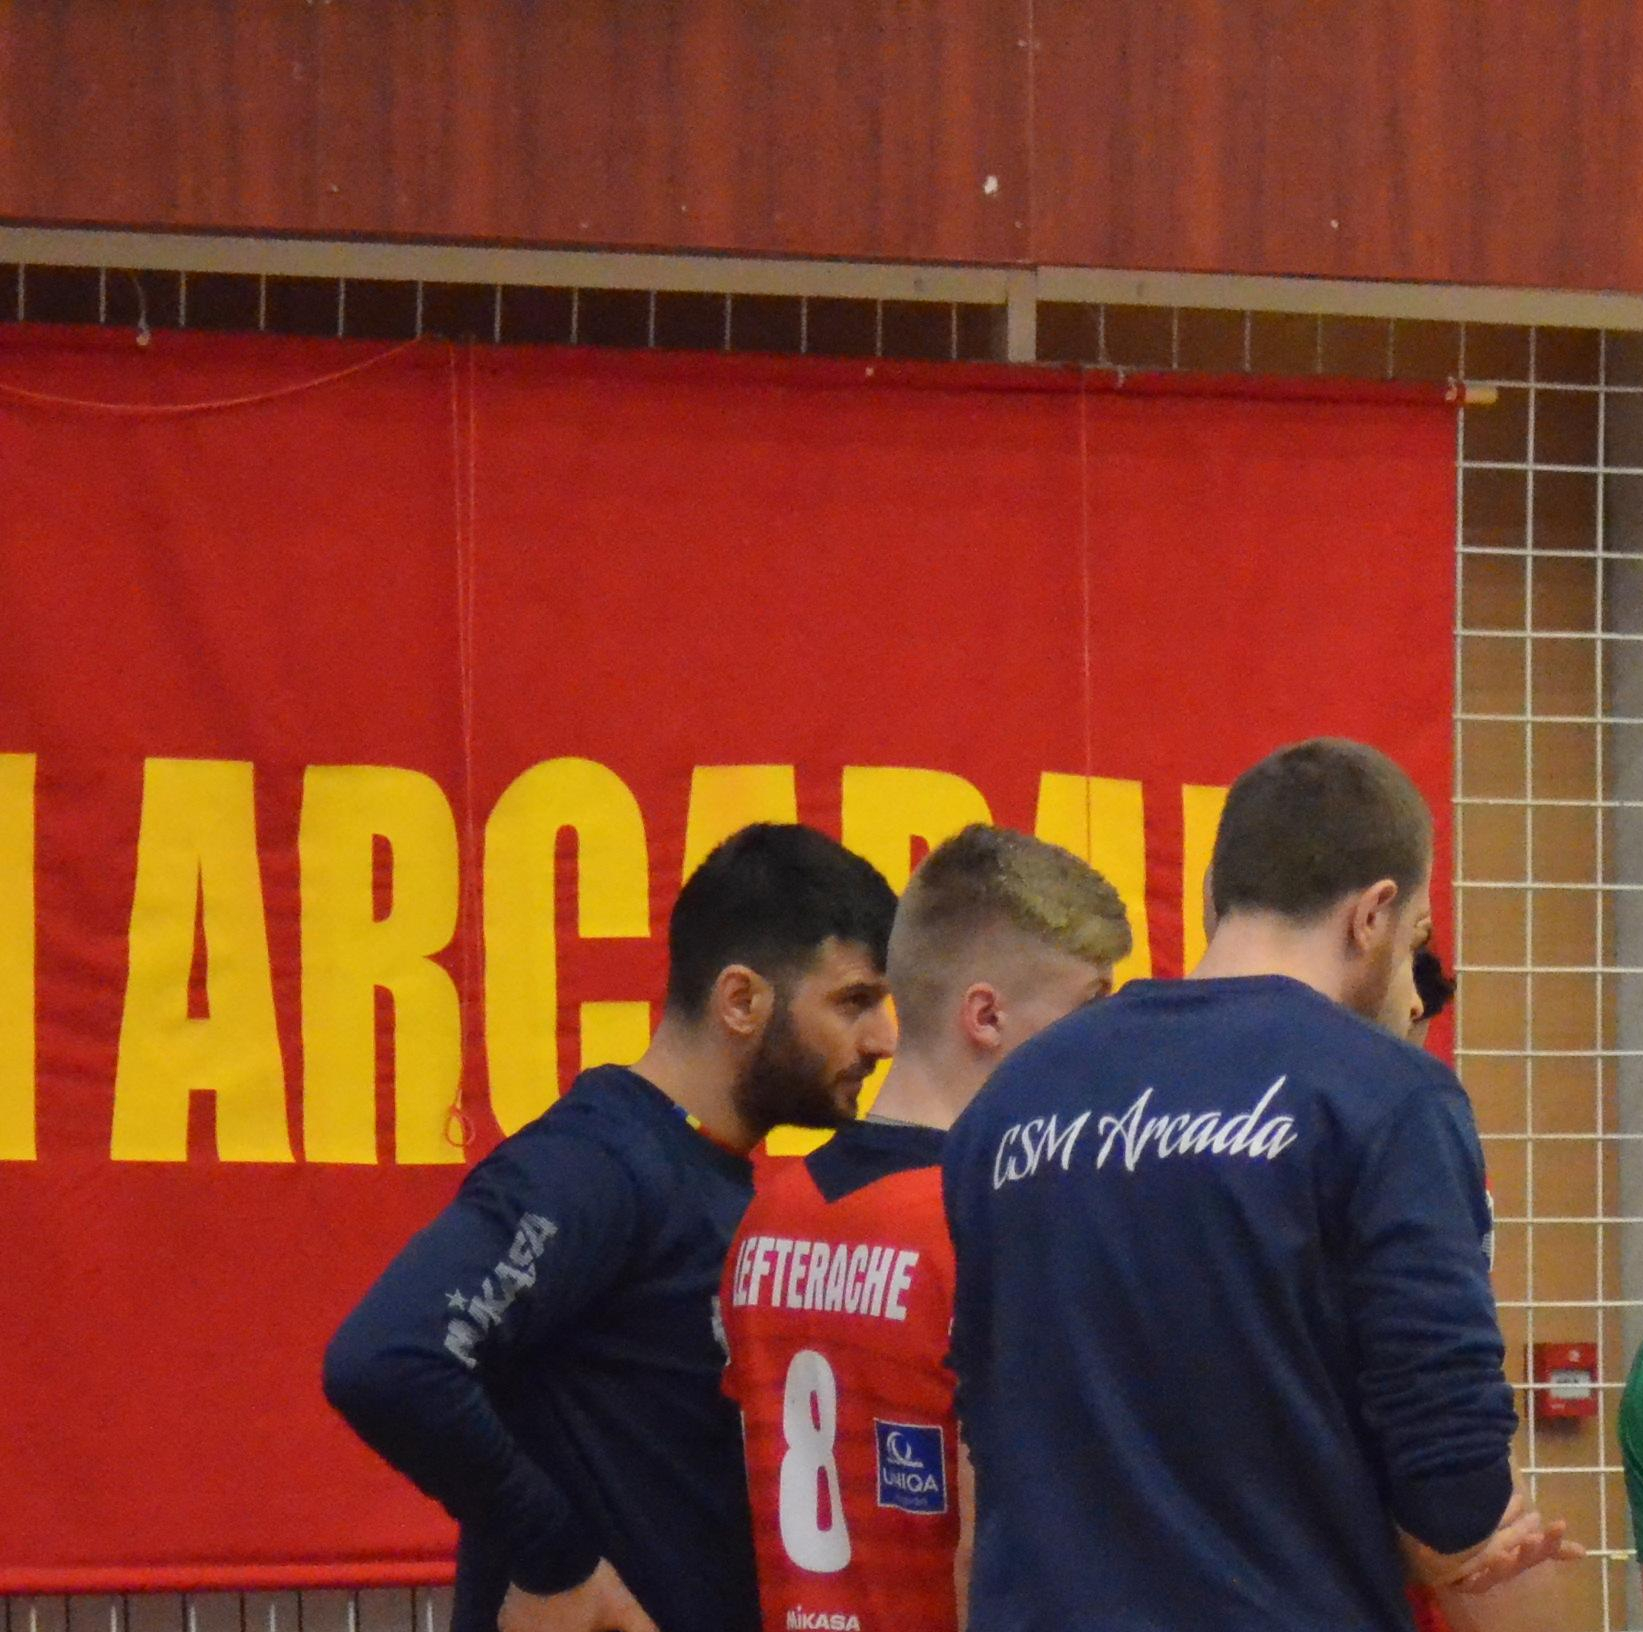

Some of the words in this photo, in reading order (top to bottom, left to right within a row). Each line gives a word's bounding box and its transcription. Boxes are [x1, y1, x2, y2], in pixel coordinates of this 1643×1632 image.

[993, 1110, 1092, 1191] CSM
[1096, 1074, 1298, 1172] Arcada
[733, 1235, 920, 1321] LEFTERACHE
[779, 1348, 852, 1574] 8
